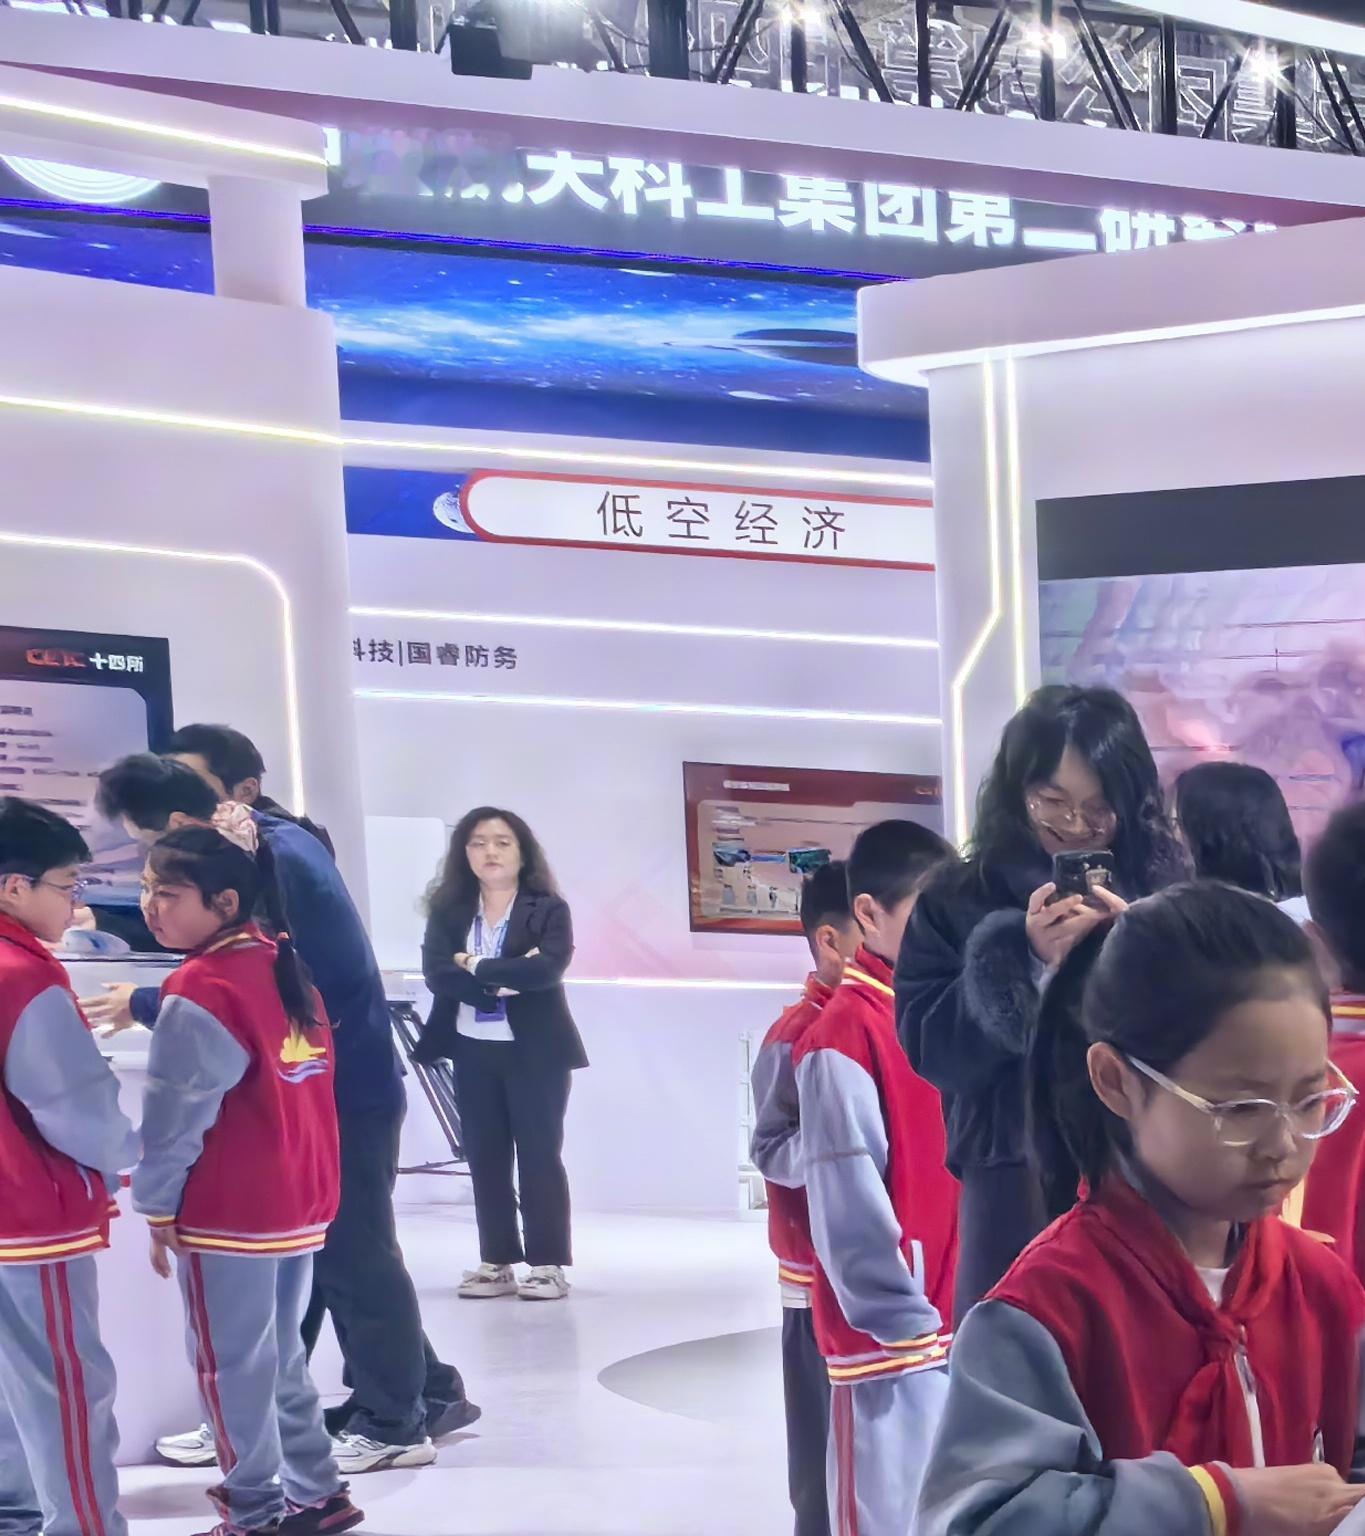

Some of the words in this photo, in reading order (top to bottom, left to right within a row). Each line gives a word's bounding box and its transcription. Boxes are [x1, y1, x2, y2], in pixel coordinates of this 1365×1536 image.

[596, 490, 846, 551] 低空经济
[88, 652, 144, 673] 十四所
